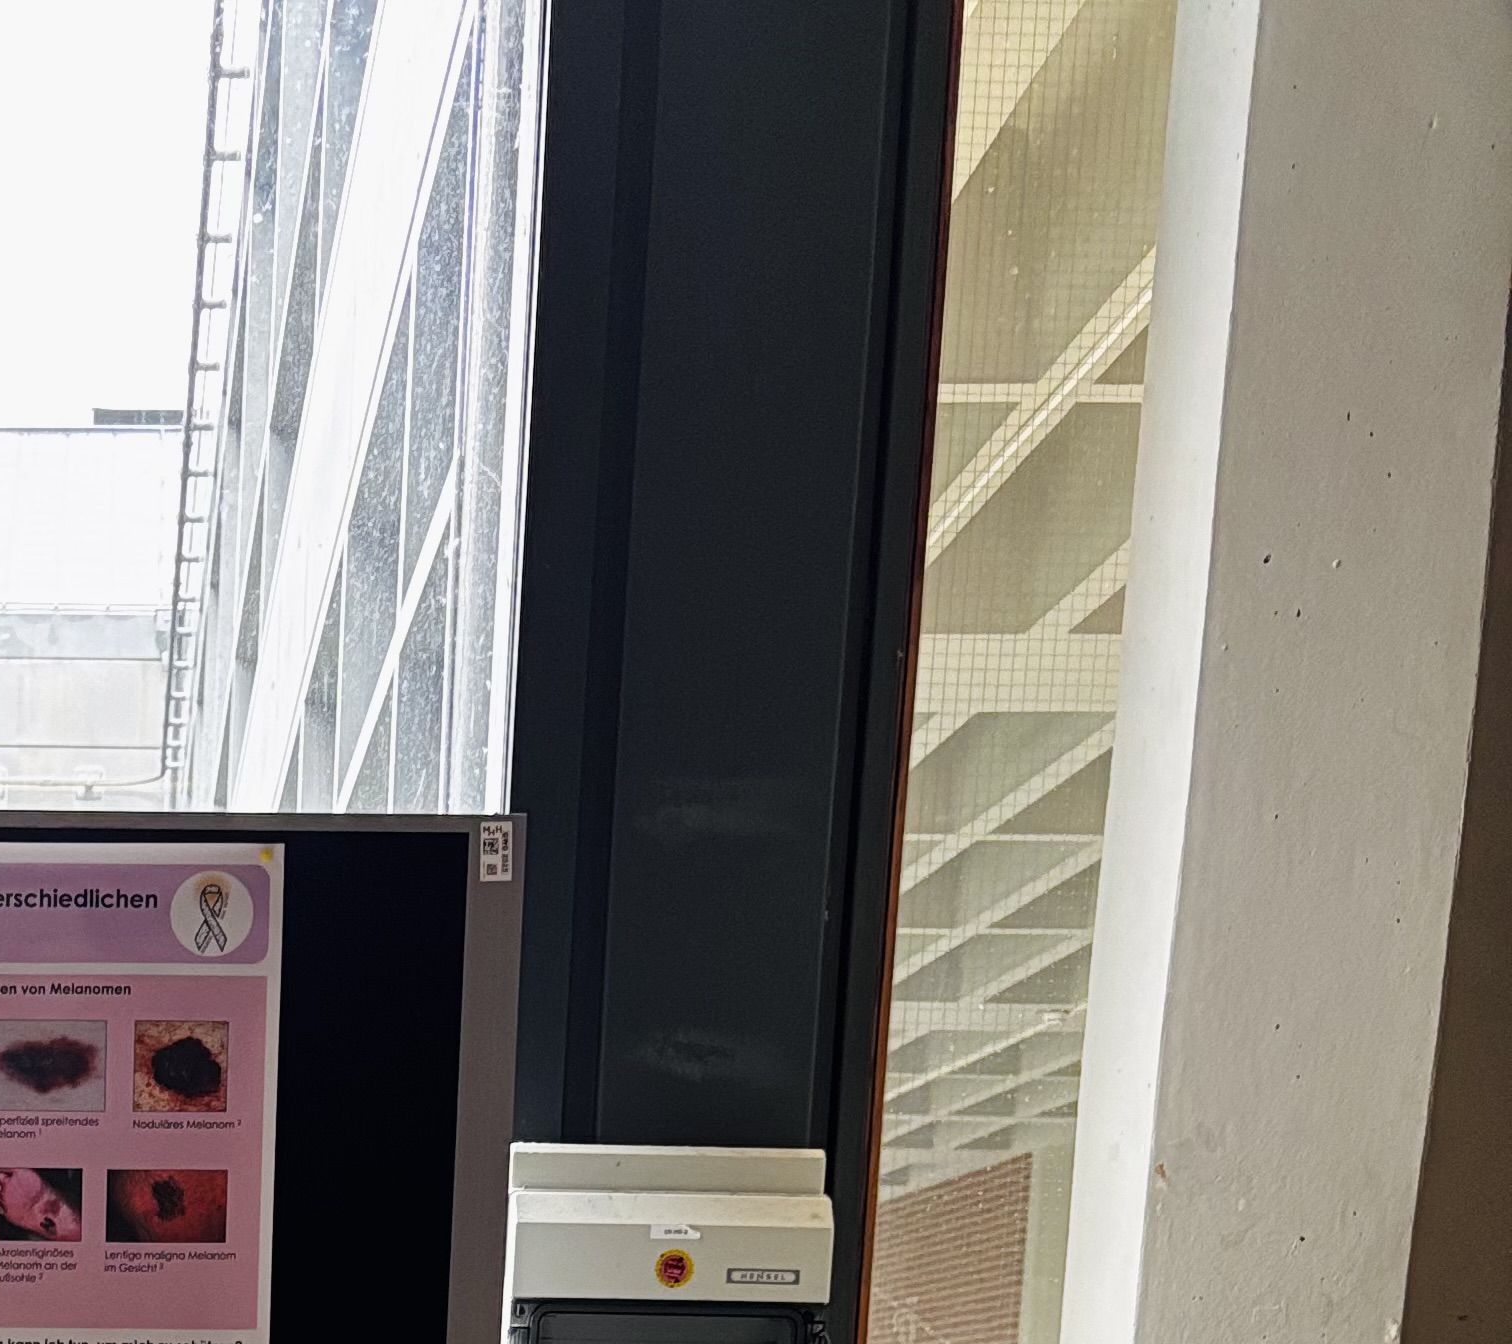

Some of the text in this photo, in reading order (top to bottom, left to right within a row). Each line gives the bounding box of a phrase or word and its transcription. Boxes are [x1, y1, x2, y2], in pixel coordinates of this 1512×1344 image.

[21, 986, 45, 995] von
[50, 983, 131, 995] Melanomen
[41, 1117, 99, 1127] spreitendes
[133, 1120, 184, 1129] Noduläres
[186, 1120, 235, 1129] Melanom
[188, 1251, 236, 1260] Melanom
[60, 1261, 77, 1270] der
[119, 1263, 157, 1272] Gesicht
